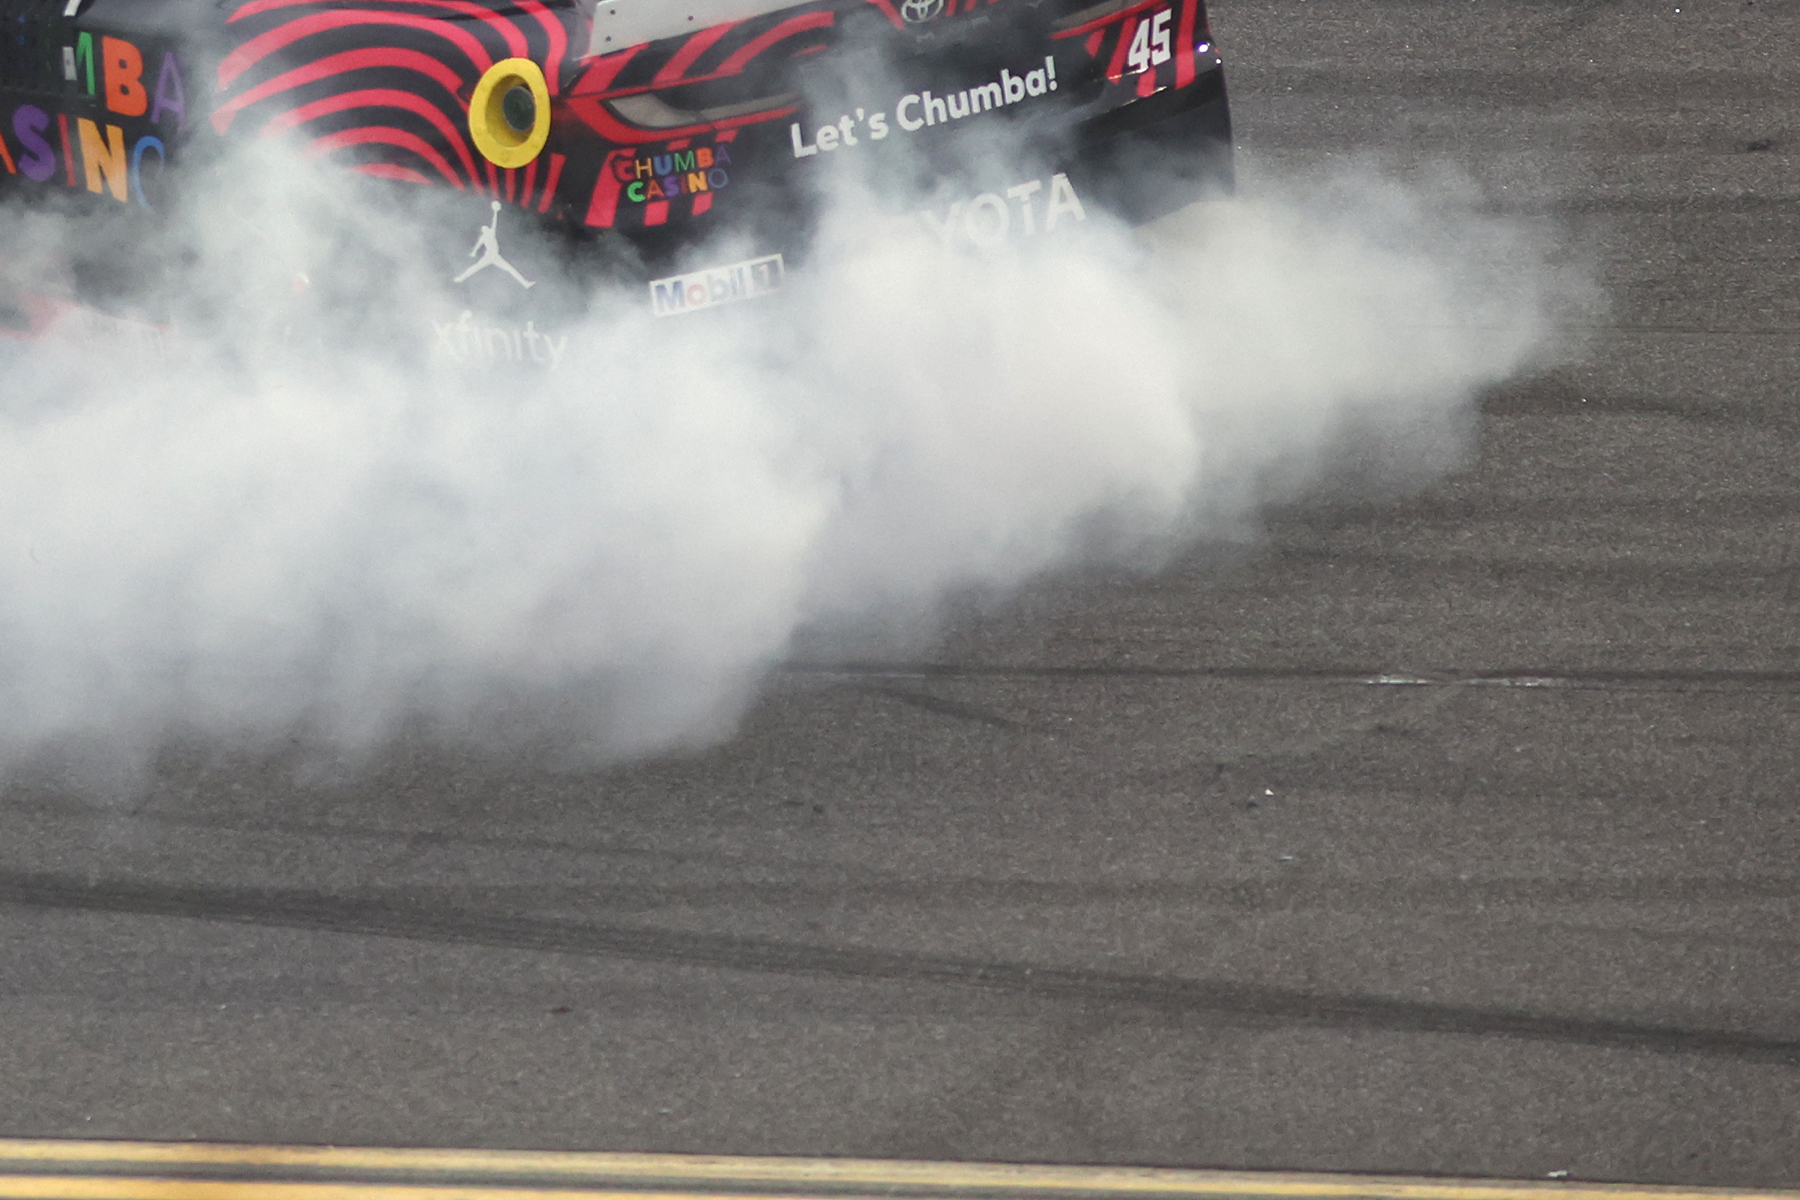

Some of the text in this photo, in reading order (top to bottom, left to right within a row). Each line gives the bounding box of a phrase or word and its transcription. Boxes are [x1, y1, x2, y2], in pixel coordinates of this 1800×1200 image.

[1127, 7, 1173, 71] 45
[790, 55, 1059, 158] Let's Chumba!
[614, 143, 732, 182] CHUMBA
[626, 167, 729, 203] CASINO
[654, 266, 746, 313] Mobil
